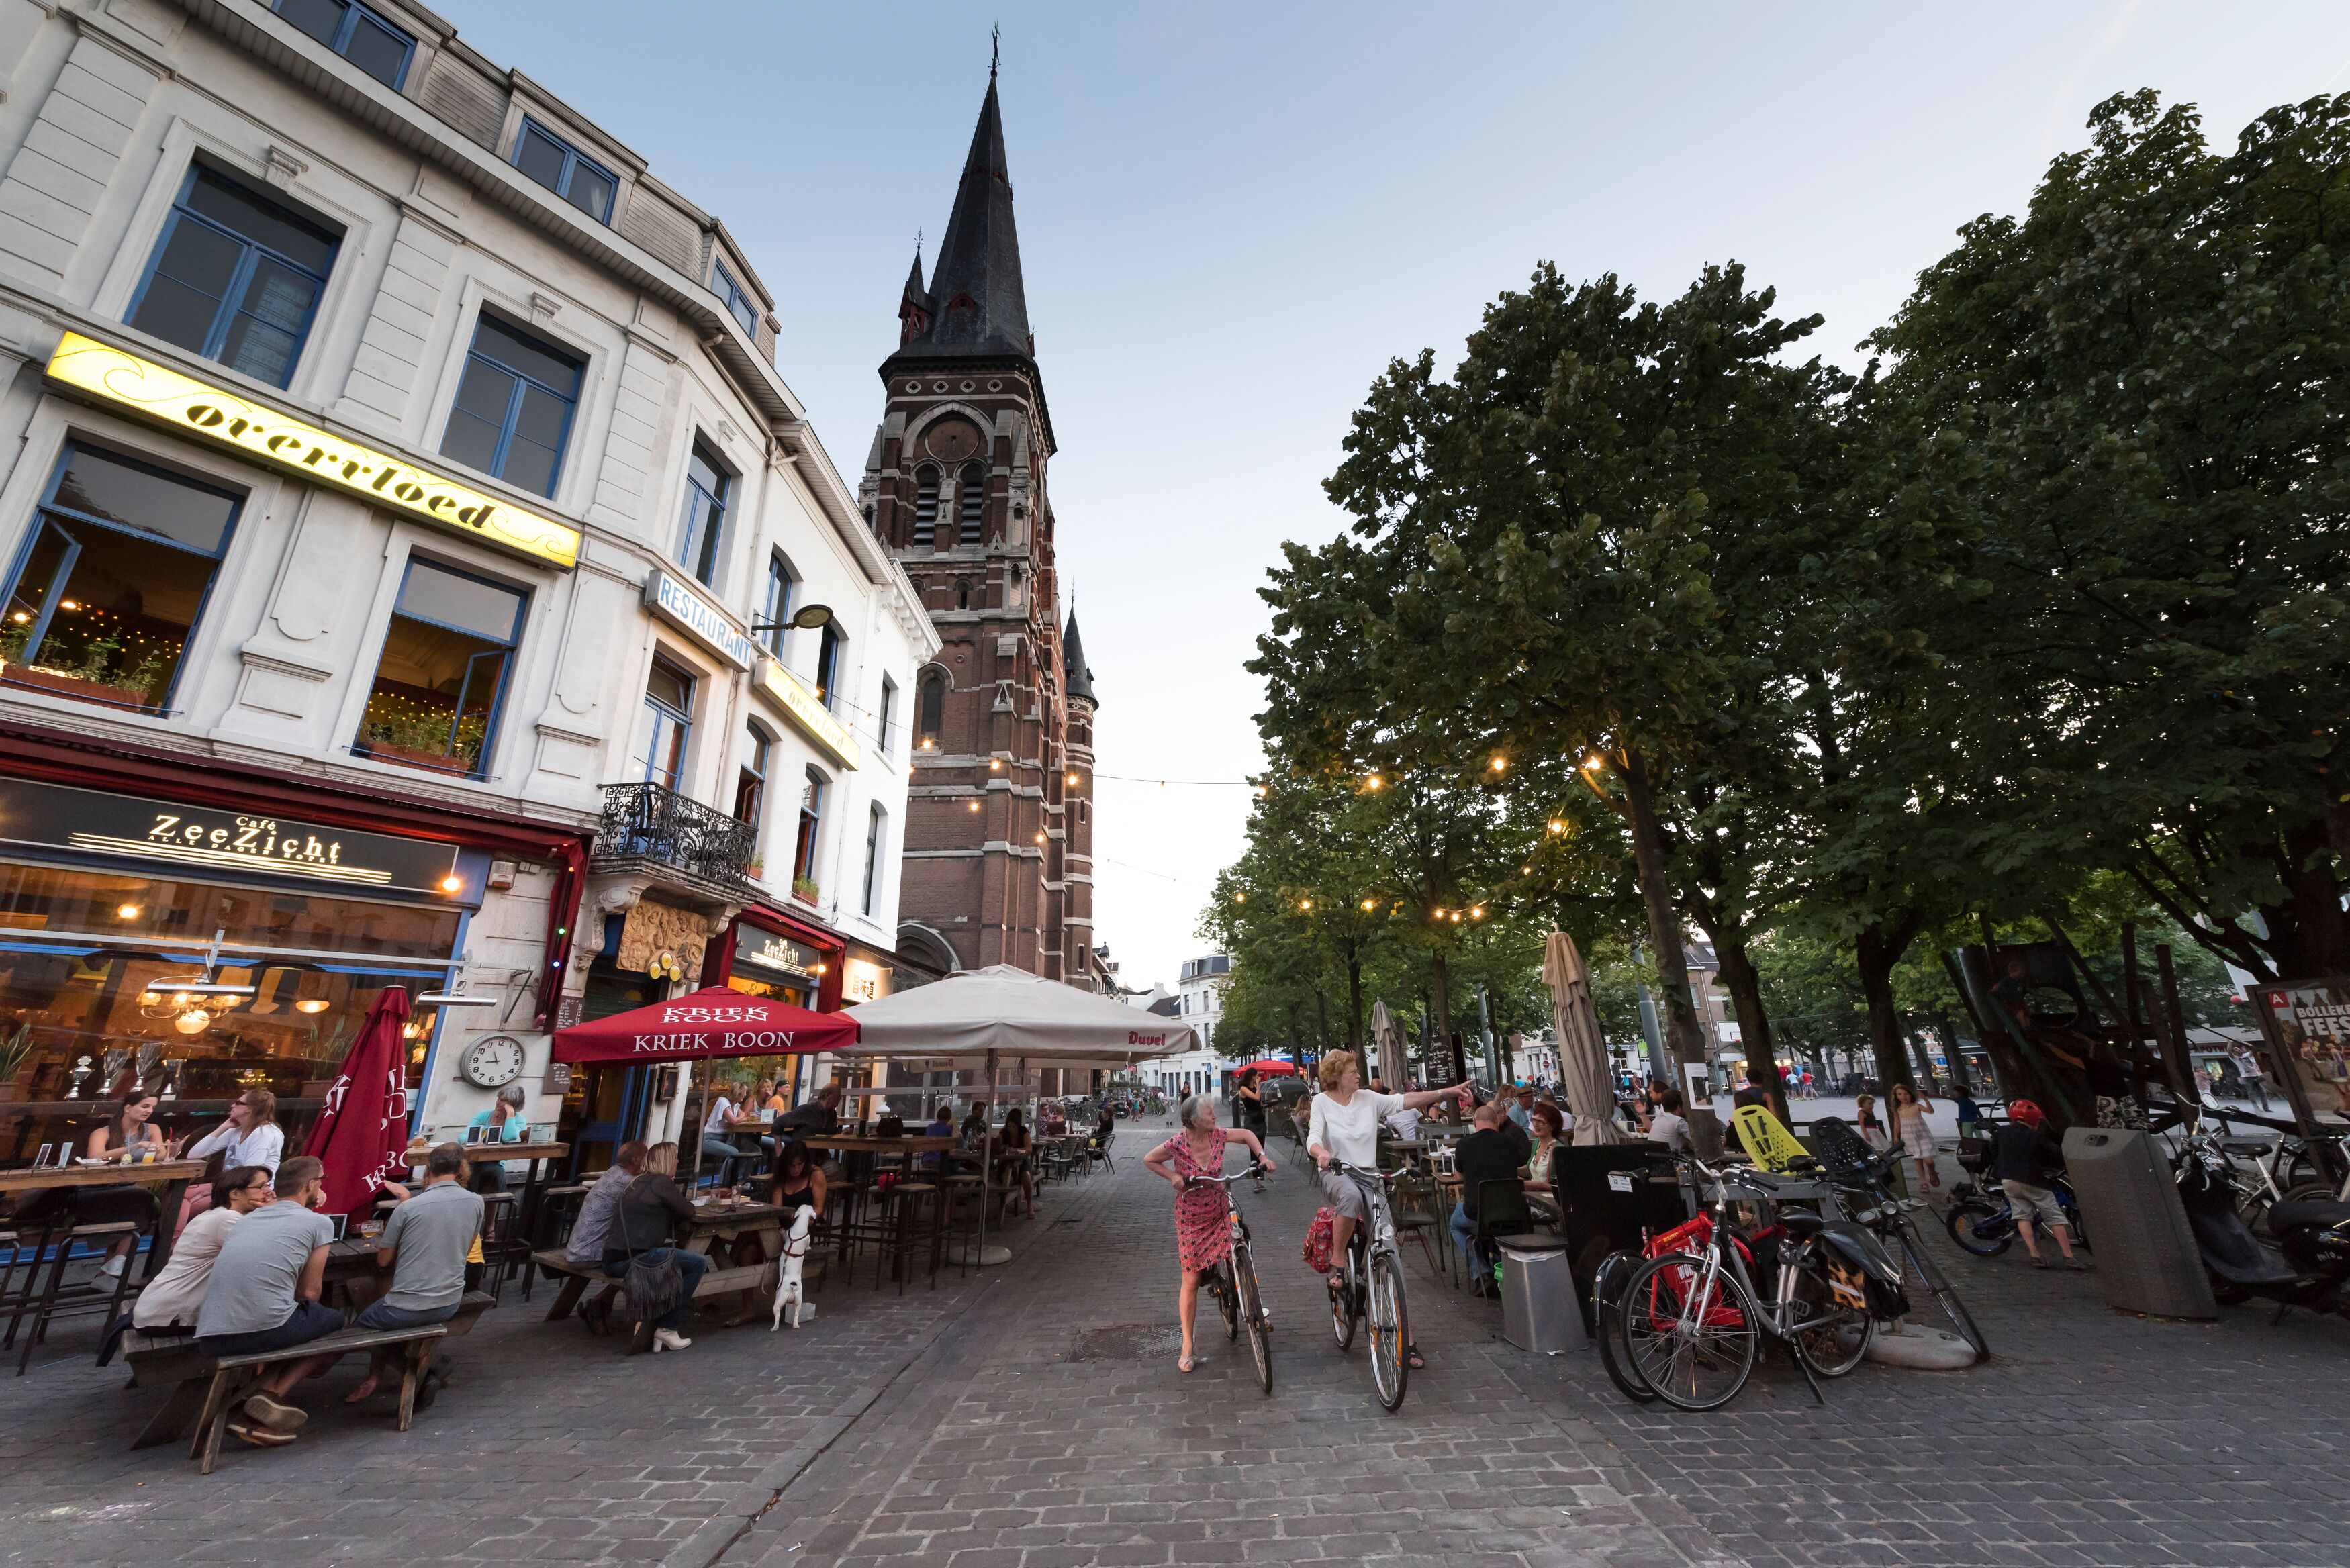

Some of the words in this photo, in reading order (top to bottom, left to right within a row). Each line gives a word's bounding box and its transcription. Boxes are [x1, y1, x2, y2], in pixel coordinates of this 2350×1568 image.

[186, 404, 496, 530] overvloed
[660, 577, 751, 664] RESTAURANT
[236, 816, 276, 830] Café
[148, 835, 196, 846] ALLE
[211, 843, 270, 855] DAGEN
[149, 814, 341, 859] ZeeZicht
[764, 940, 798, 962] ZeeZicht
[2273, 993, 2284, 1004] A
[659, 1014, 767, 1023] BOON
[663, 1006, 769, 1016] KRIEK
[633, 1033, 710, 1052] KRIEK
[722, 1032, 794, 1048] BOON
[1128, 1030, 1166, 1046] Duvel
